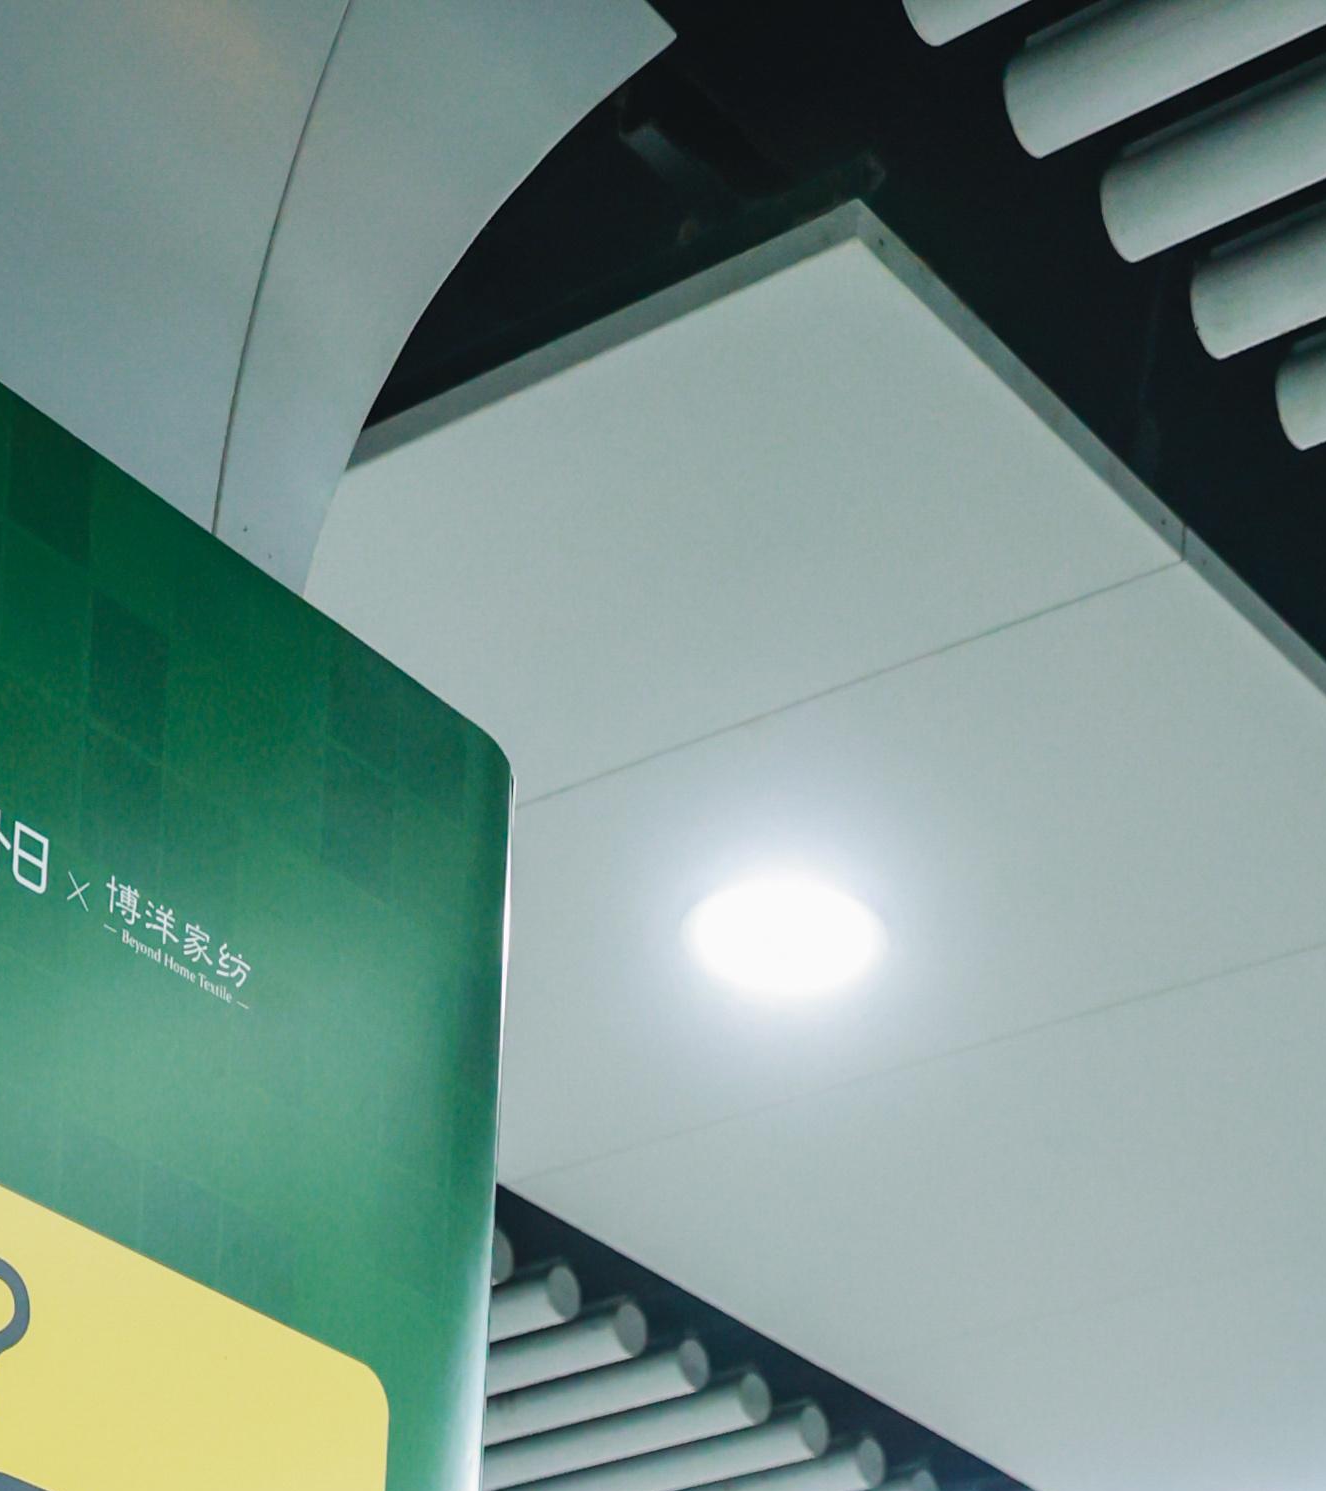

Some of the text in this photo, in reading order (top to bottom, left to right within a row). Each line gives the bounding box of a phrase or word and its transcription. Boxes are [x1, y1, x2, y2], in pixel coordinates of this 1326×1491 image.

[106, 875, 251, 987] 博洋家纺
[122, 928, 233, 1003] Beyond Home Textile
